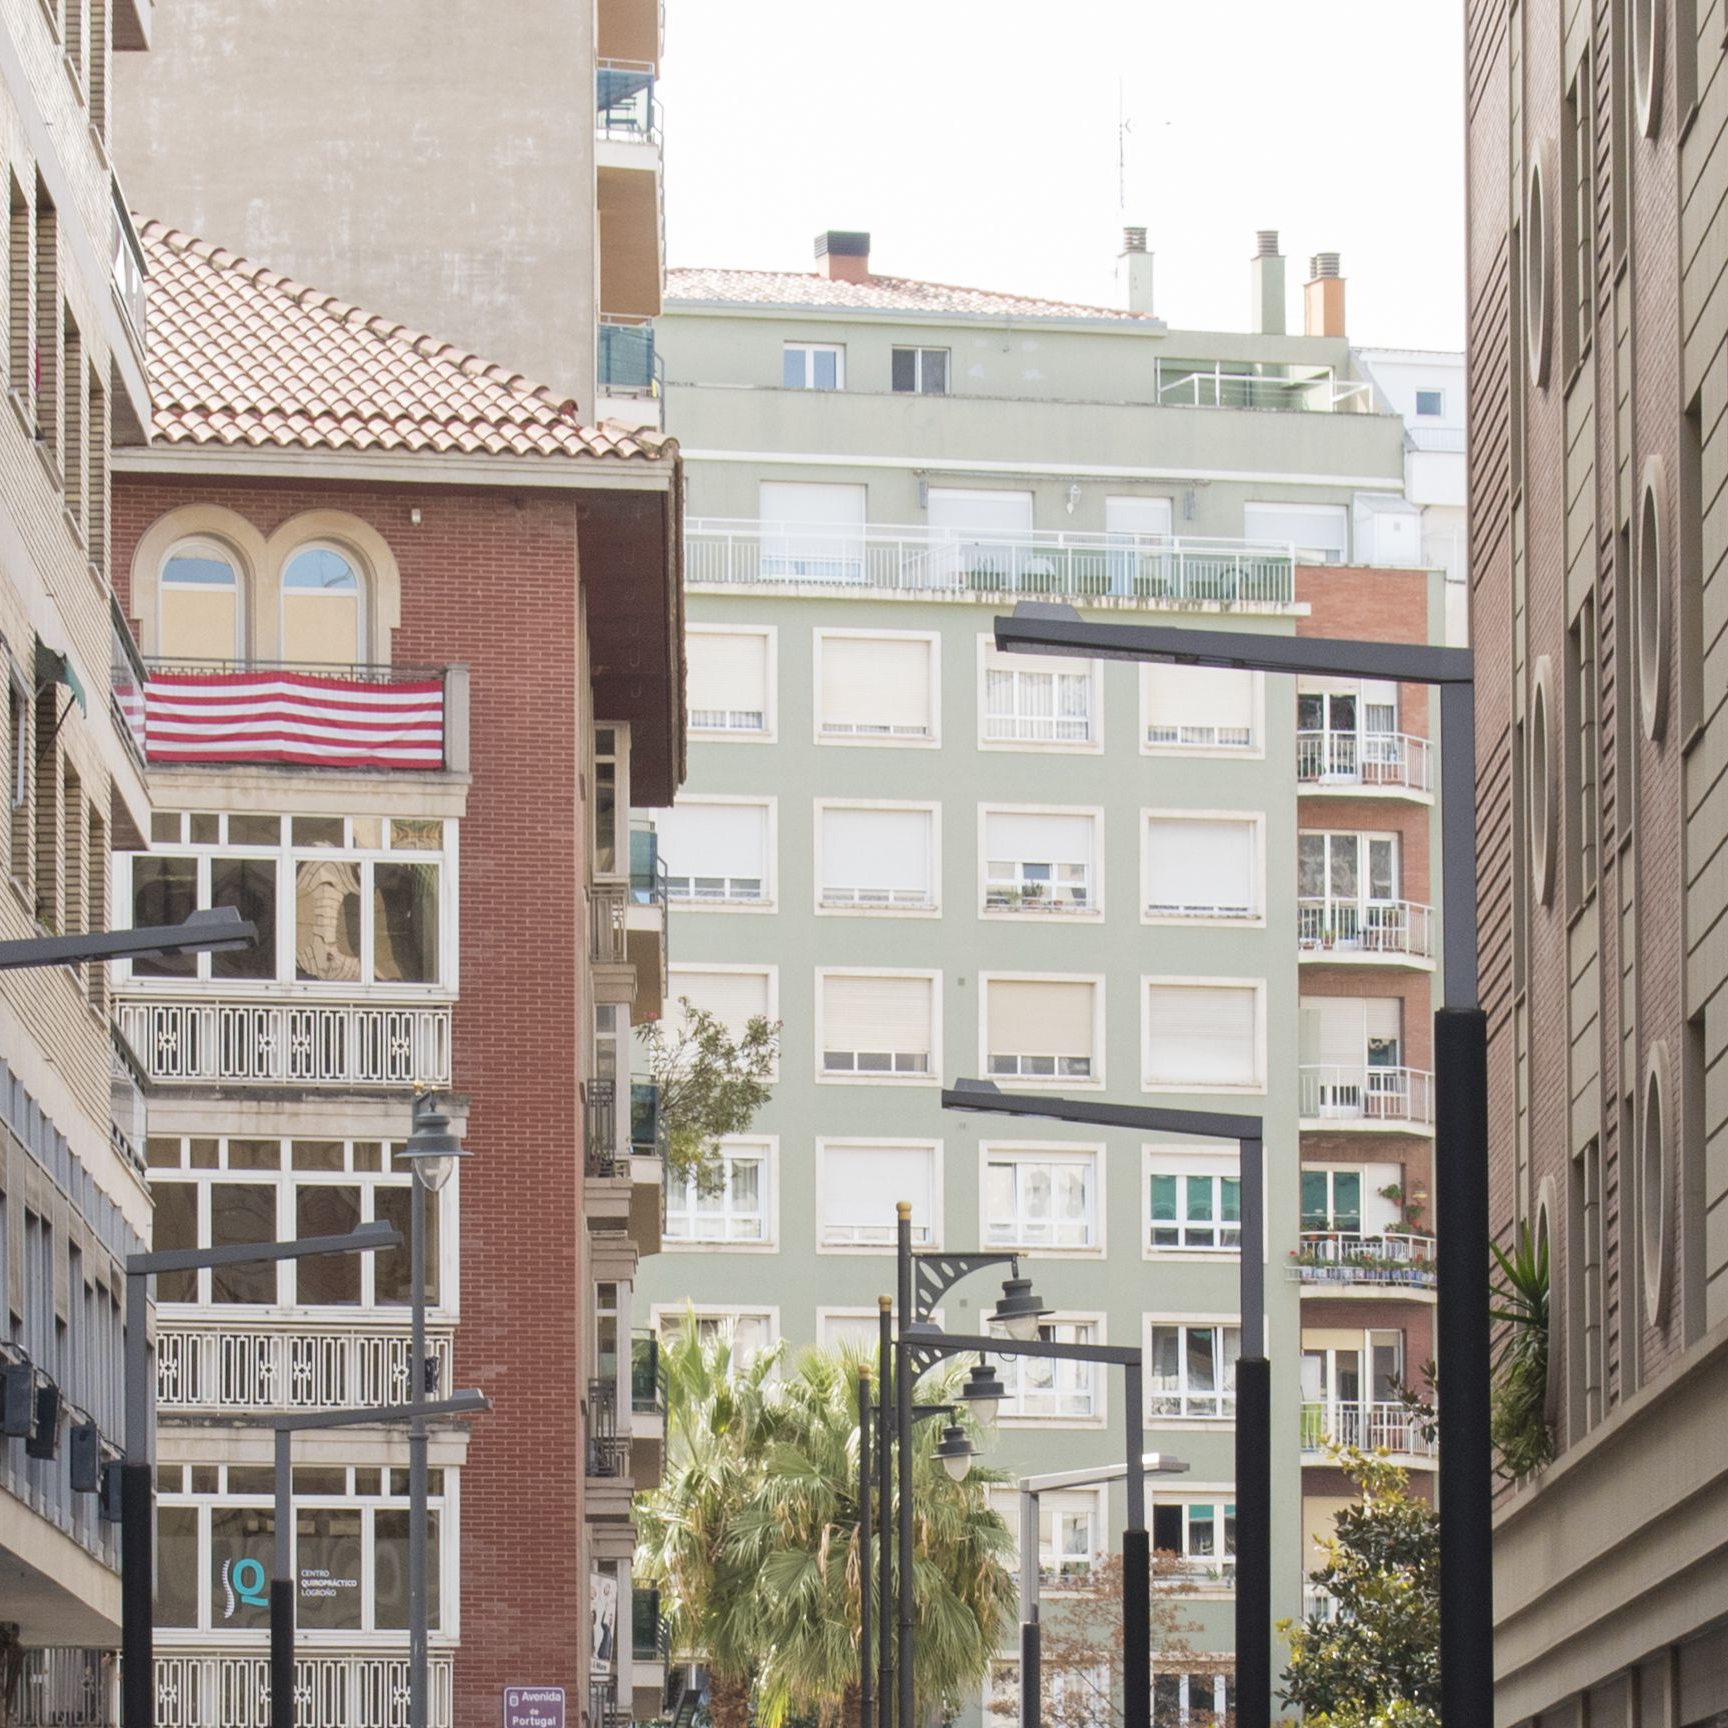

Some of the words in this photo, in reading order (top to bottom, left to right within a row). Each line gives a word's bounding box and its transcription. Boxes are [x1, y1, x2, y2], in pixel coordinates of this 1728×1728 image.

[301, 1569, 330, 1577] CENTRO
[301, 1588, 337, 1597] LOGROÑO
[521, 1691, 562, 1702] Avenida
[529, 1708, 540, 1716] de
[512, 1716, 556, 1728] Portugal
